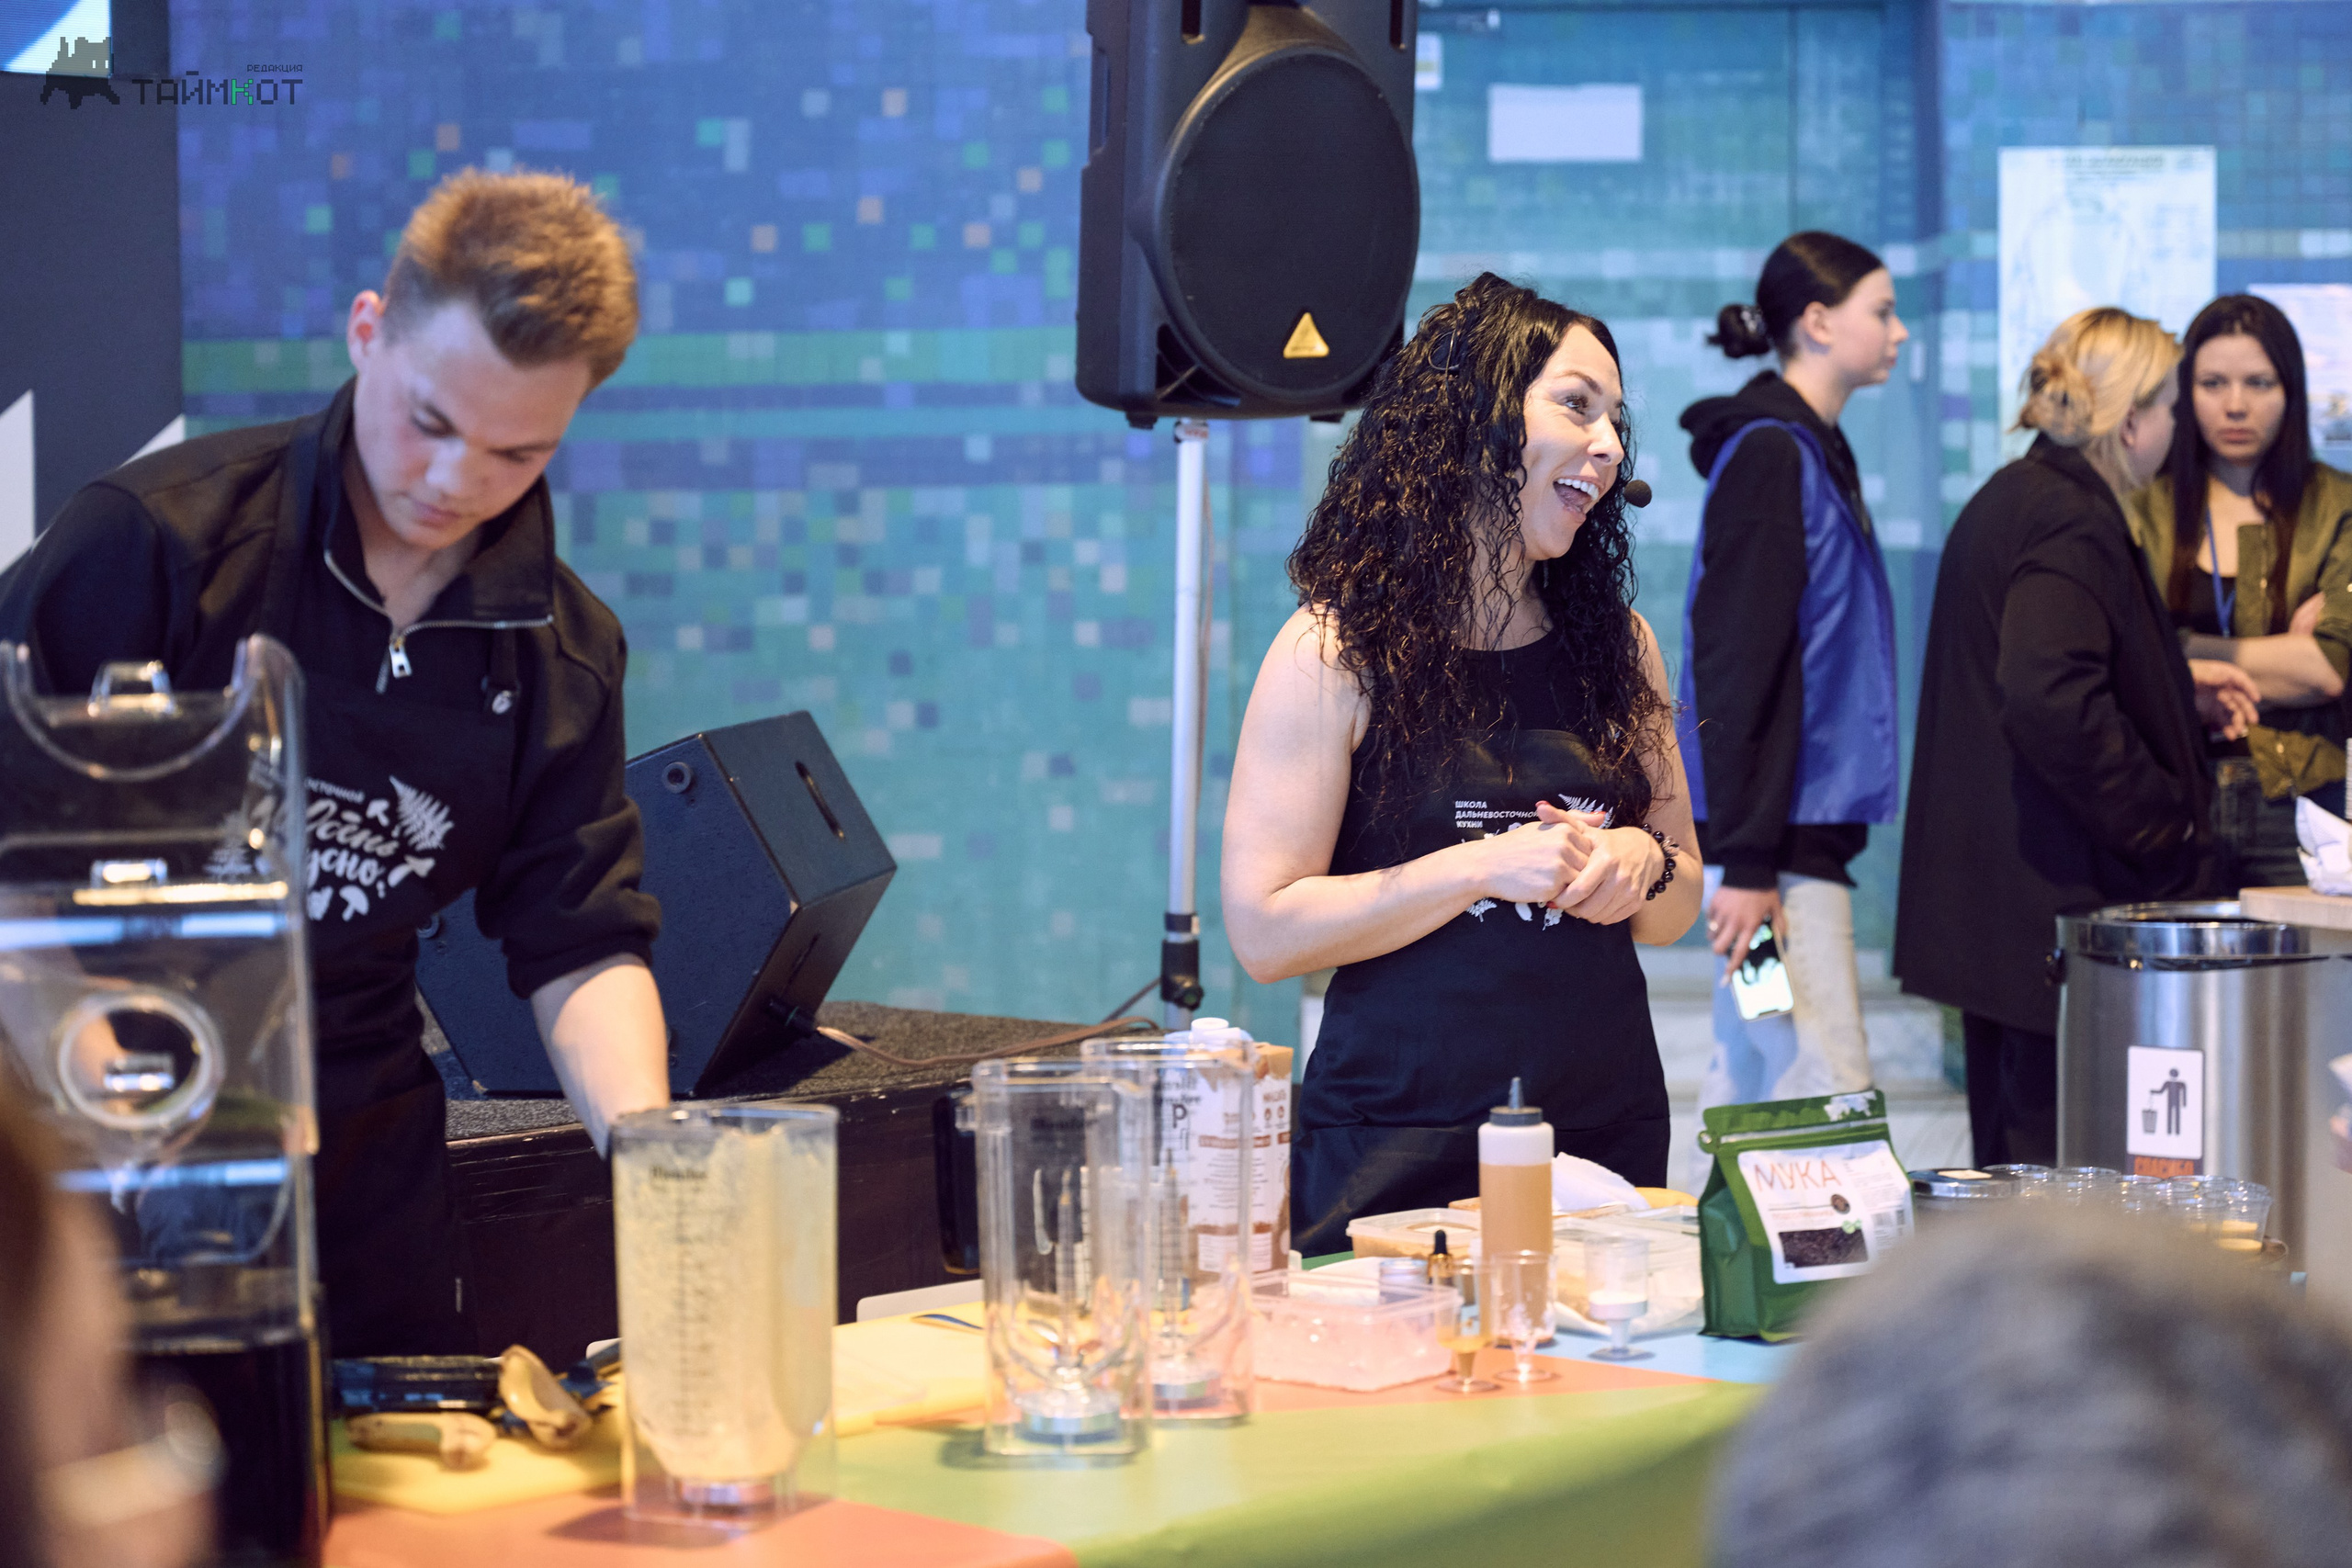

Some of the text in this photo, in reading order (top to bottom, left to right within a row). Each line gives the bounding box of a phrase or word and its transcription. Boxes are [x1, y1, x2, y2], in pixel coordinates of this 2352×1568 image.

[1455, 800, 1487, 808] ШКОЛА
[1456, 820, 1483, 829] КУХНИ
[1754, 1159, 1842, 1191] МУКА
